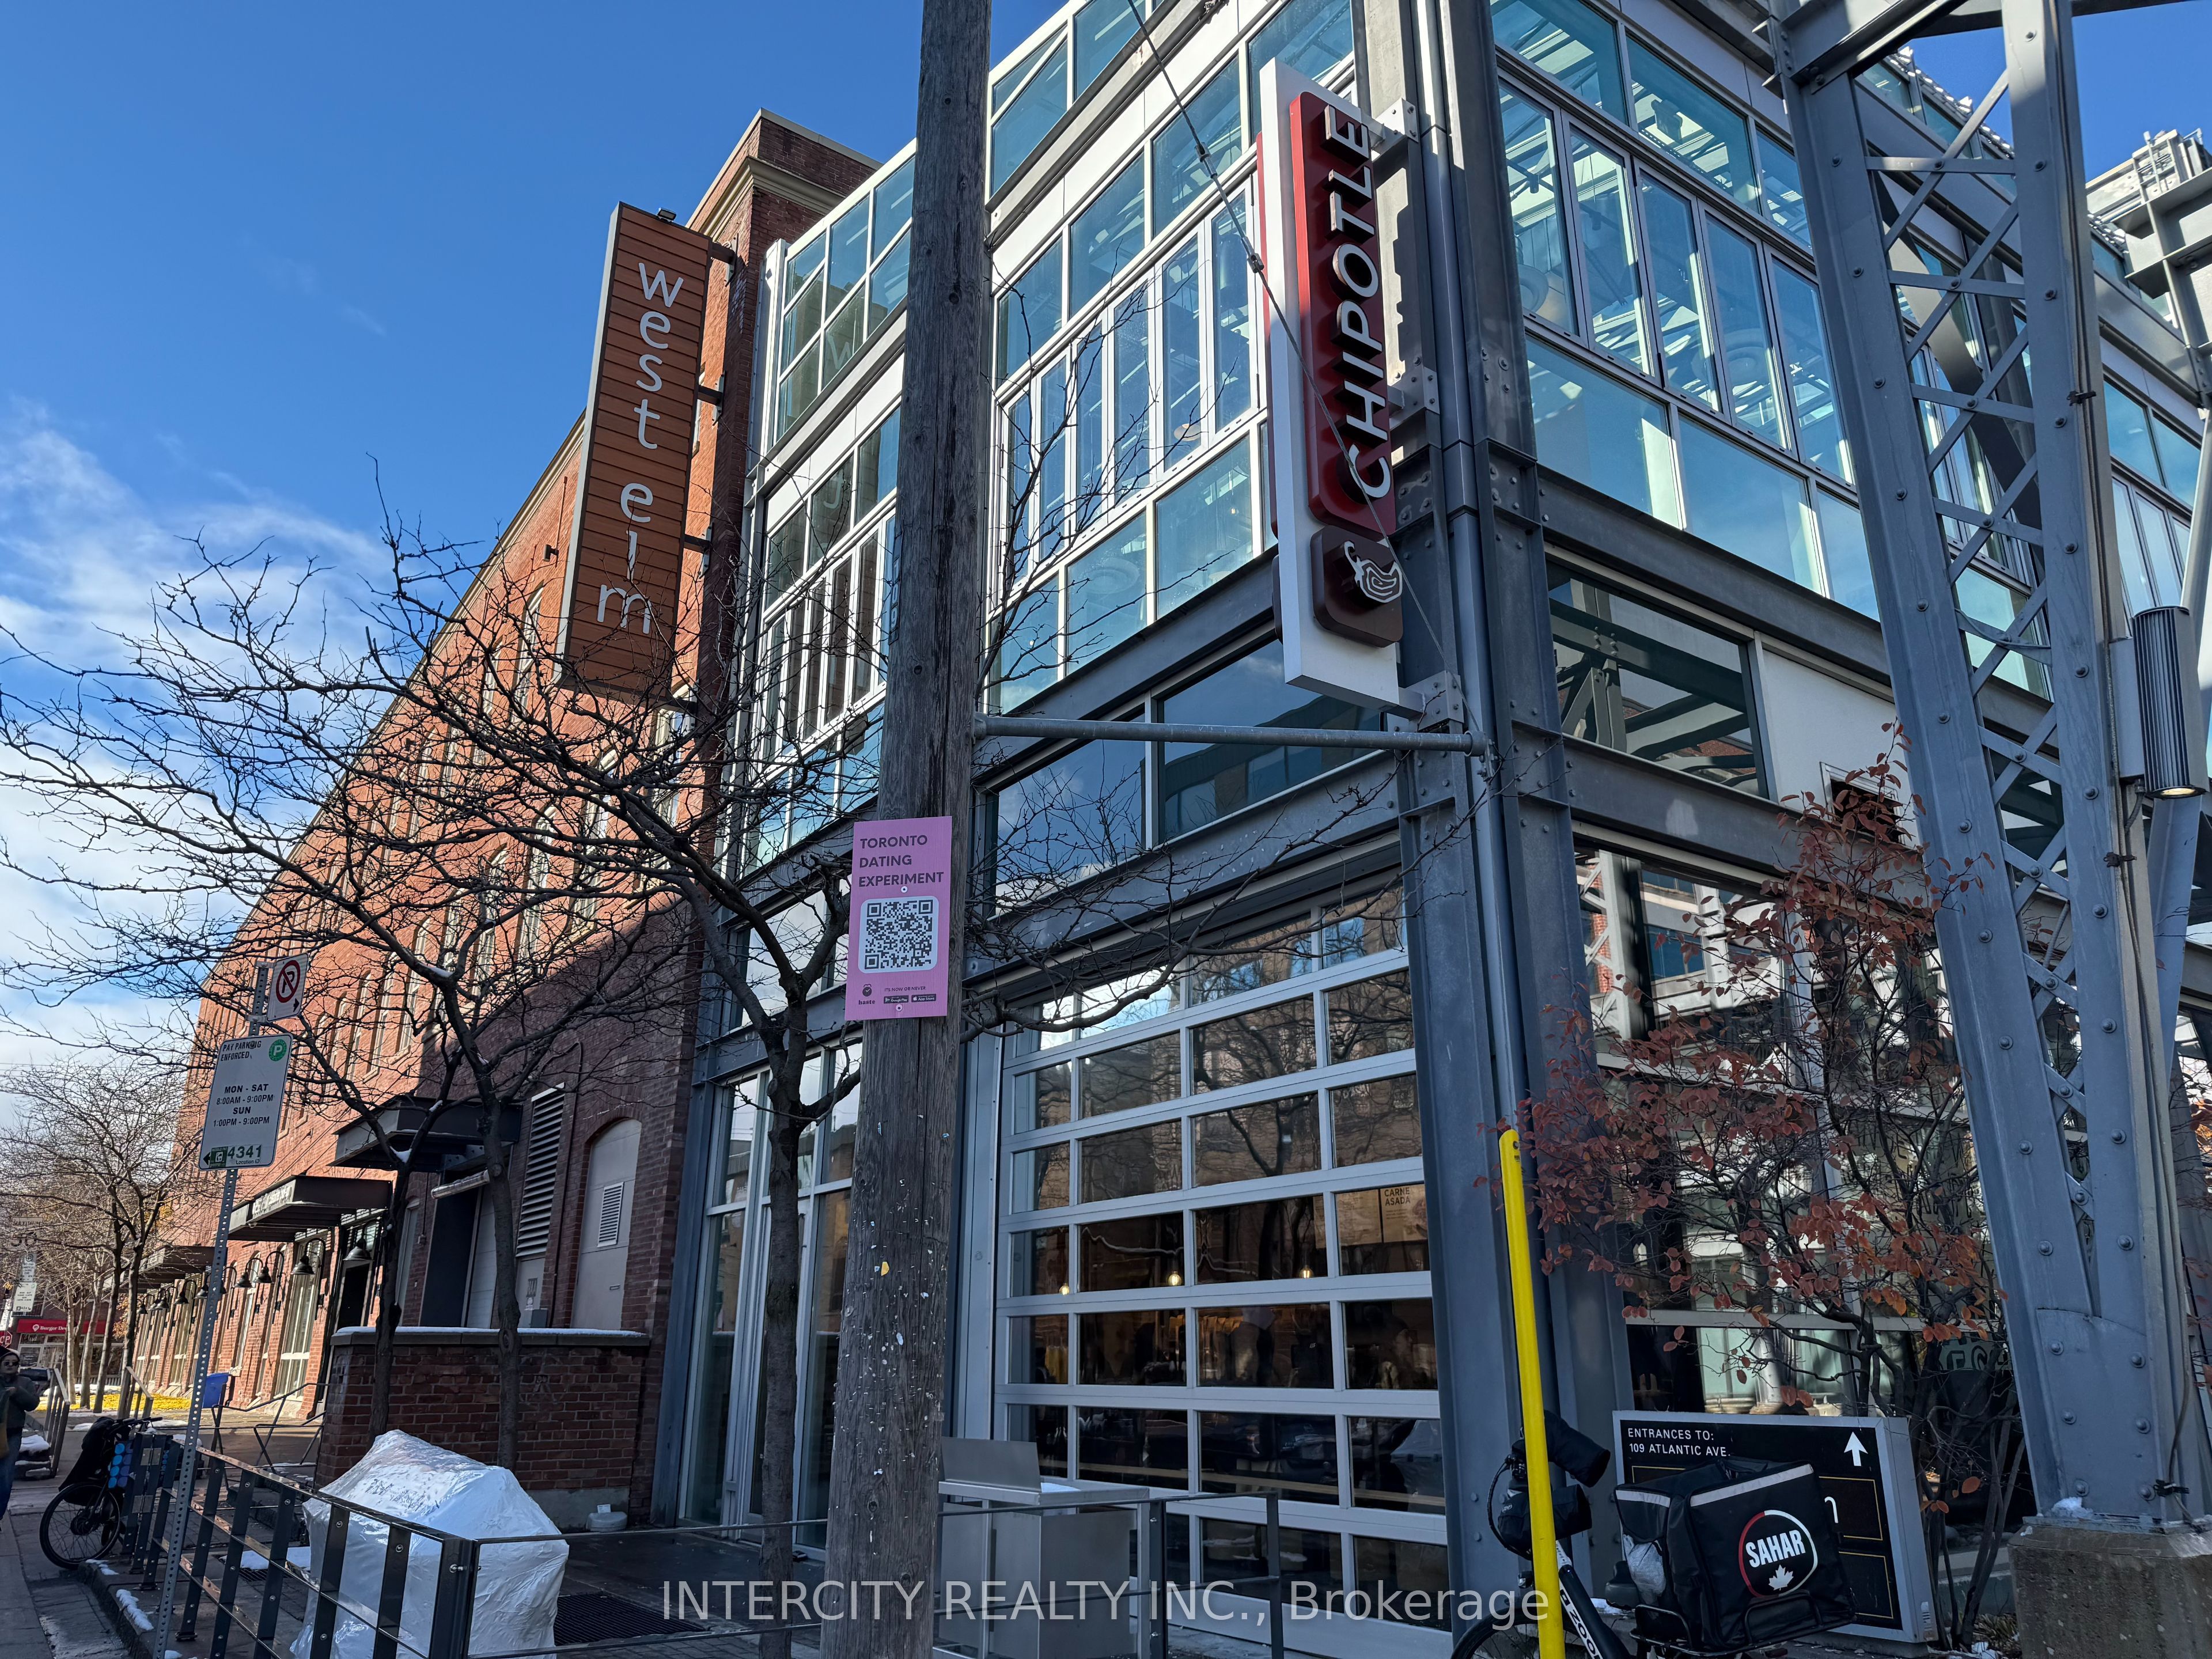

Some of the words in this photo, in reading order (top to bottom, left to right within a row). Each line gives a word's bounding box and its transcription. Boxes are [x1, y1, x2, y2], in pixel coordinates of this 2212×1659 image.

[1324, 105, 1392, 503] CHIPOTLE
[634, 262, 684, 450] west
[597, 483, 654, 634] elm
[860, 835, 928, 849] TORONTO
[859, 855, 912, 868] DATING
[859, 872, 944, 887] EXPERIMENT
[222, 1044, 234, 1052] PAY
[221, 1051, 249, 1061] ENFORCED
[225, 1085, 243, 1093] MON
[217, 1096, 241, 1105] 8:00AM
[247, 1094, 274, 1103] 9:00PM
[233, 1107, 251, 1115] SUN
[214, 1118, 237, 1127] 1:00PM
[243, 1116, 270, 1125] 9:00PM
[228, 1145, 262, 1159] 4341
[1384, 1187, 1410, 1197] CARNE
[1385, 1196, 1411, 1206] ASADA
[1628, 1427, 1691, 1440] ENTRANCES
[1695, 1430, 1714, 1441] TO:
[1629, 1443, 1645, 1453] 109
[1649, 1444, 1701, 1455] ATLANTIC
[1706, 1446, 1731, 1456] AVE.
[1745, 1529, 1806, 1568] SAHAR
